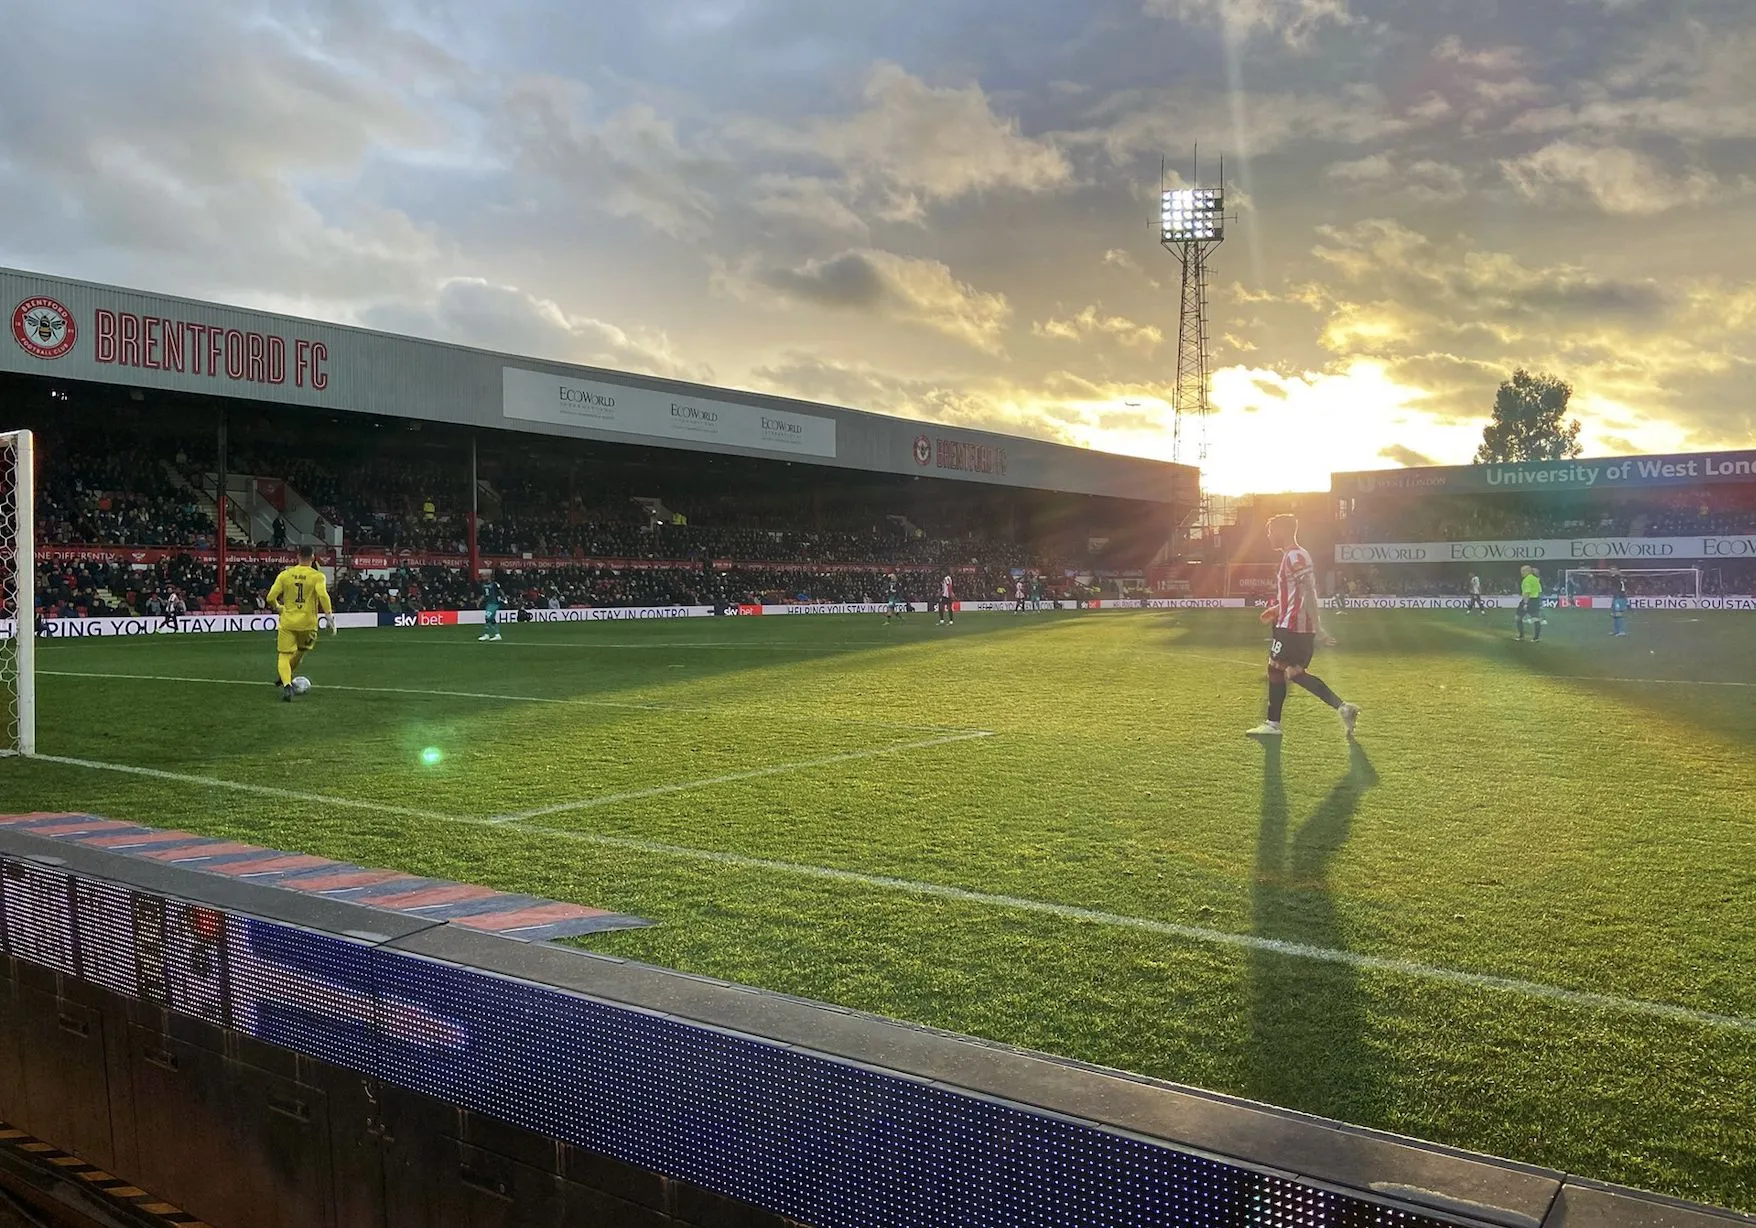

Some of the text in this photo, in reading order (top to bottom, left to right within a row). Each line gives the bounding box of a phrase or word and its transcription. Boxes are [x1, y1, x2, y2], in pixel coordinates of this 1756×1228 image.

[21, 299, 68, 318] BRENTFORD
[21, 338, 52, 355] FOOTBALL
[95, 308, 328, 390] BRENTFORD FC
[1486, 463, 1599, 486] University
[1606, 461, 1632, 480] of
[1637, 460, 1698, 478] West
[294, 583, 305, 603] 1
[723, 606, 754, 616] sky bet
[1323, 599, 1502, 608] HEPING YOU STAY IN CONROL
[1542, 599, 1558, 608] sky
[1629, 599, 1687, 608] HELPING
[394, 612, 443, 627] sky bet
[561, 610, 589, 622] YOU
[592, 610, 621, 621] STAY
[624, 609, 637, 620] IN
[111, 620, 157, 636] YOU
[223, 618, 243, 632] IN
